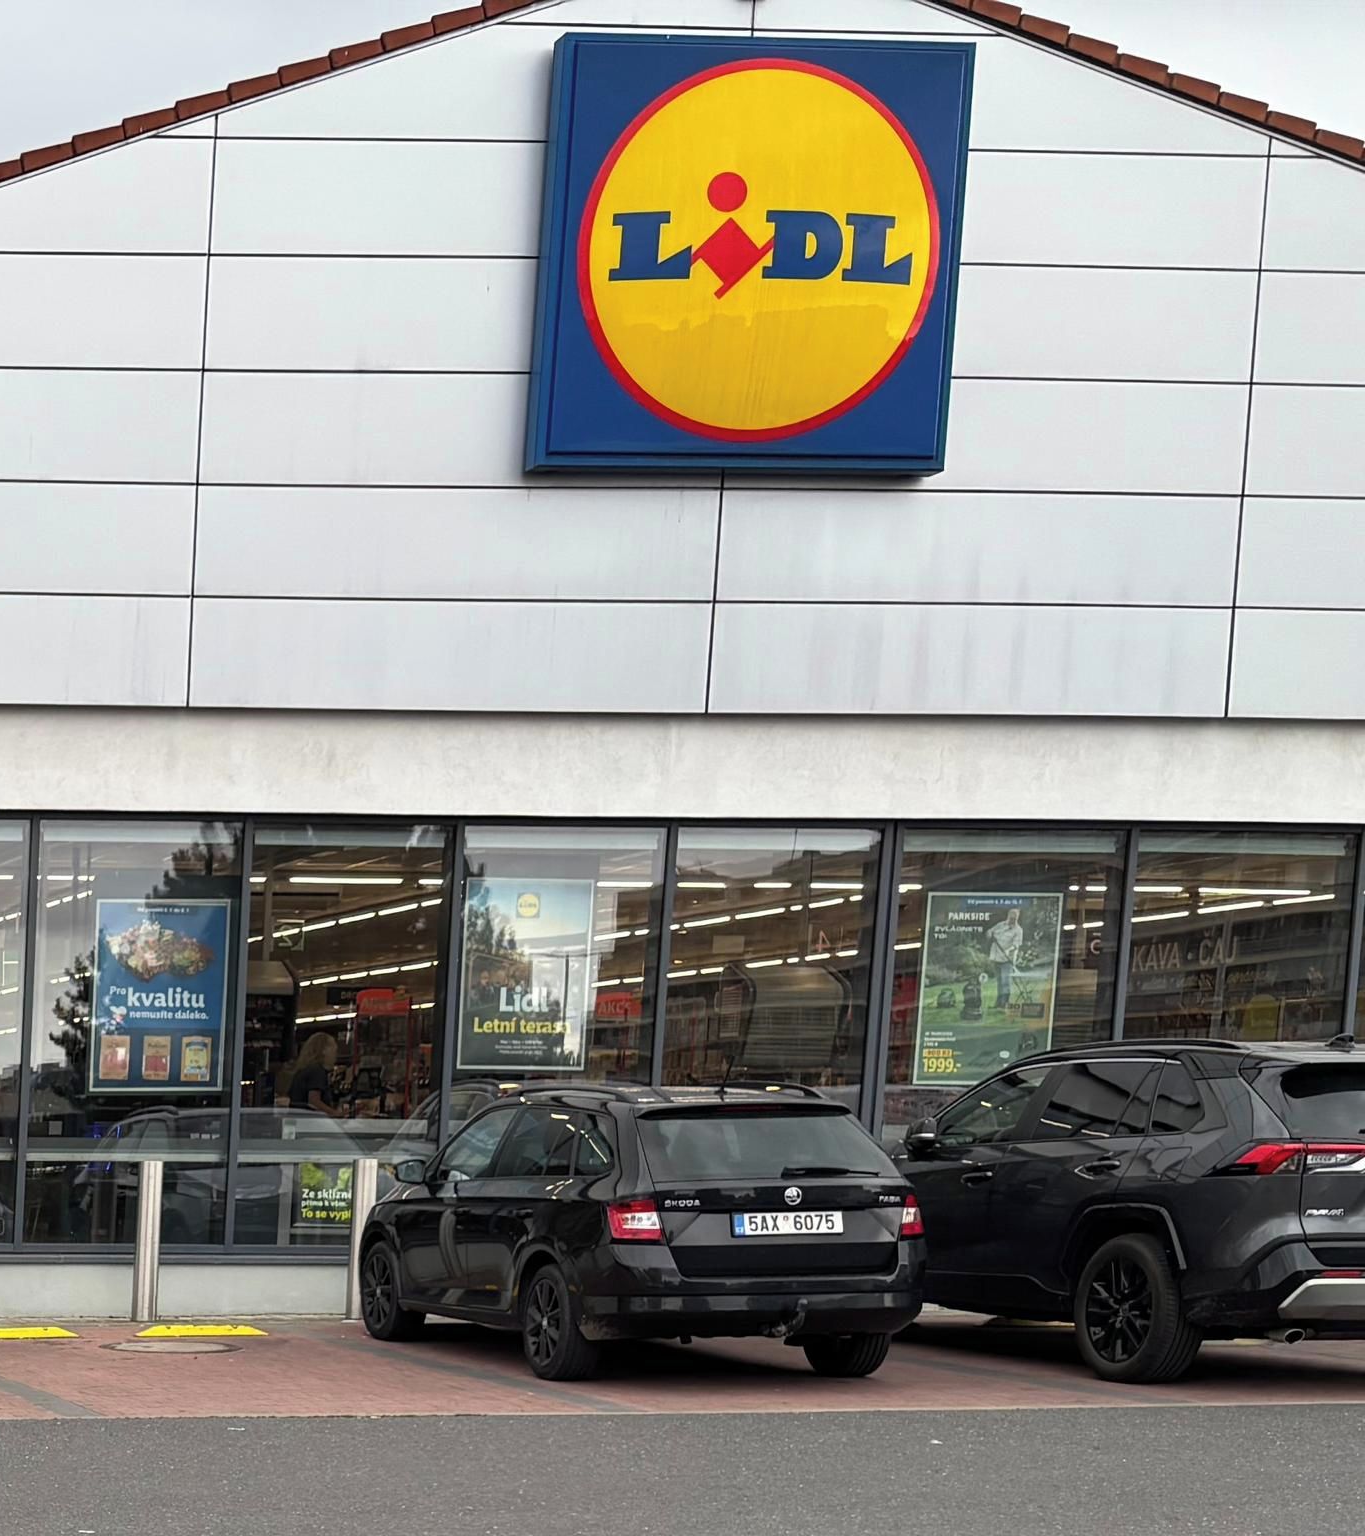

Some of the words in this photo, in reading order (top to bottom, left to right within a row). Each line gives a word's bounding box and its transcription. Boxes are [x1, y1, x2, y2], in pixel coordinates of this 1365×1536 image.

[948, 912, 990, 921] PARKSIDE
[1132, 936, 1181, 972] KÁVA
[110, 986, 126, 995] Pro
[127, 987, 205, 1008] kvalitu
[499, 986, 549, 1012] Lidl
[129, 1010, 173, 1019] nemusíte
[175, 1010, 209, 1020] daleko.
[474, 1017, 516, 1033] Letní
[520, 1019, 571, 1034] terasa
[302, 1188, 315, 1199] Ze
[301, 1208, 314, 1218] To
[748, 1214, 780, 1232] 5AX
[793, 1213, 835, 1231] 6075
